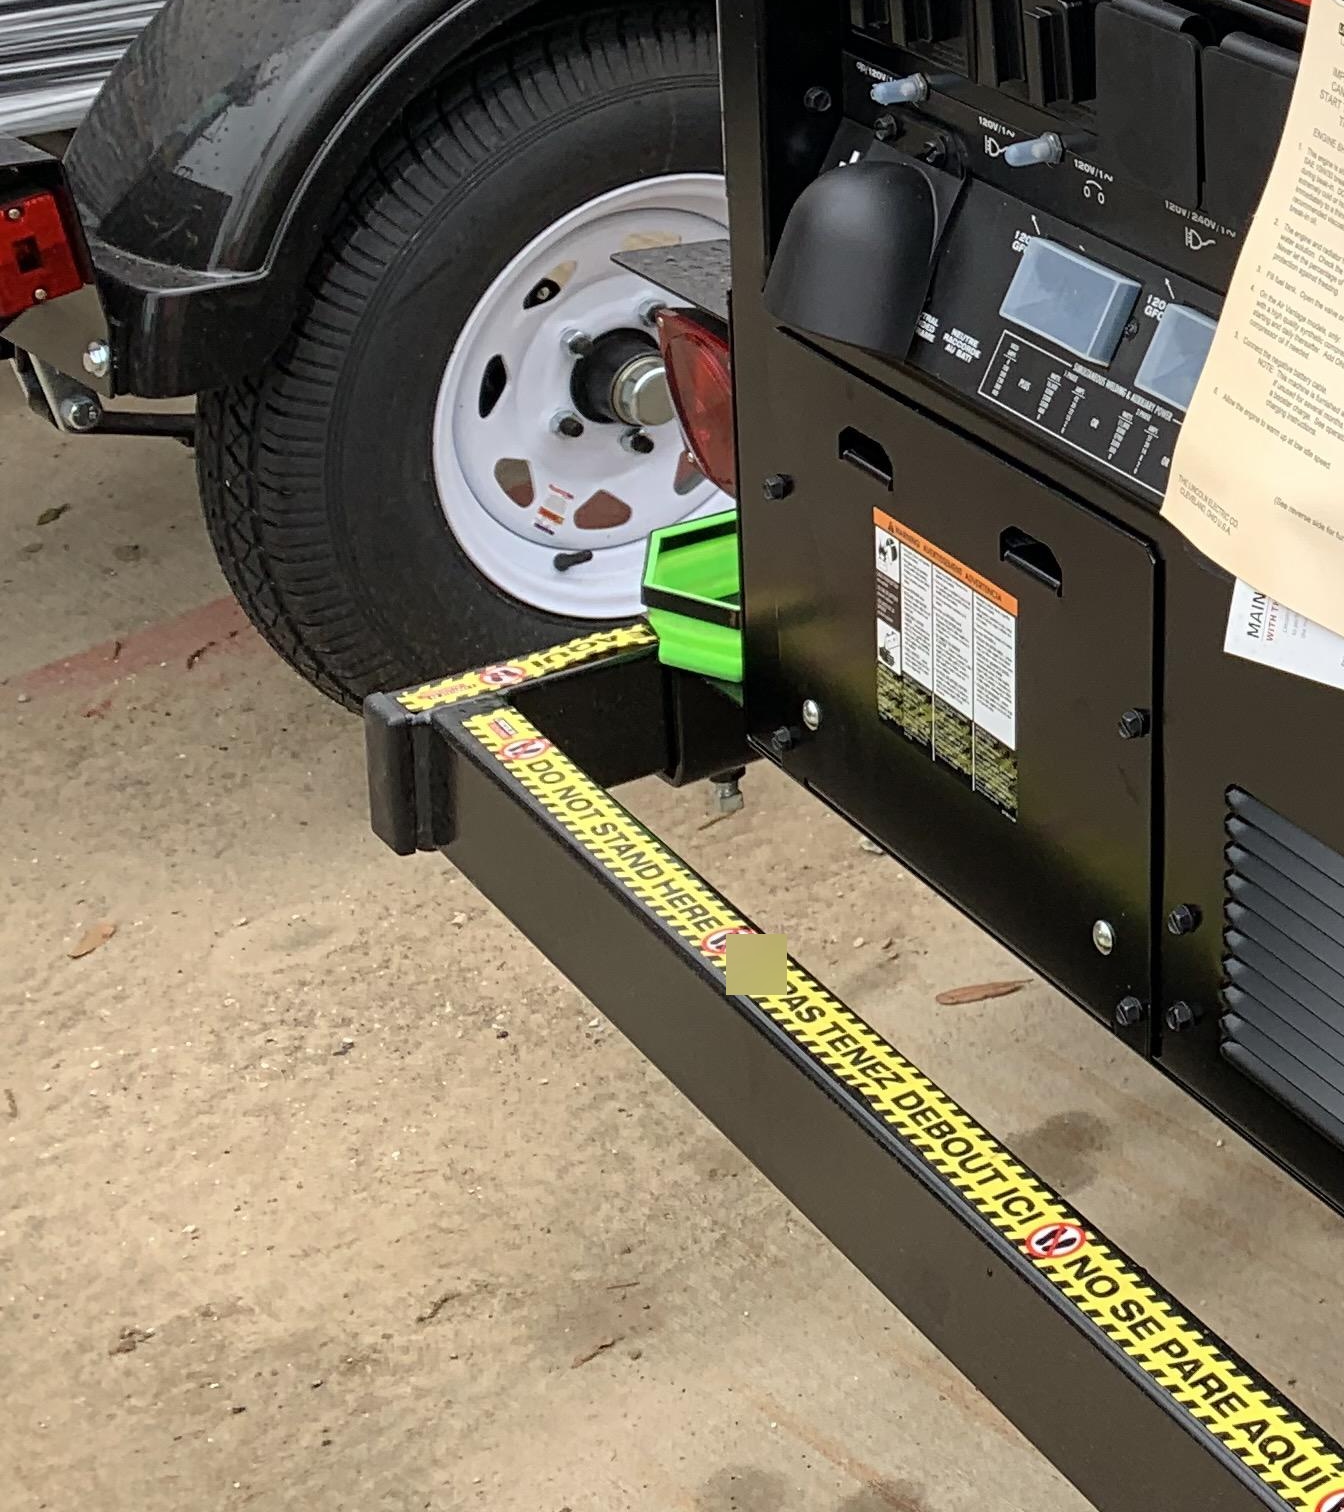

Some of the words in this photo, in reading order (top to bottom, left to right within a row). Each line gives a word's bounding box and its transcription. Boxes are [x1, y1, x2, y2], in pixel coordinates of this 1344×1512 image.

[1319, 89, 1343, 110] START
[1331, 81, 1344, 98] CAN
[951, 328, 979, 348] NEUTRE
[944, 344, 958, 356] AU
[1154, 403, 1173, 422] POWER
[1273, 496, 1289, 511] (See
[1289, 506, 1311, 523] reverse
[1312, 517, 1326, 531] side
[1326, 525, 1336, 536] for
[527, 759, 566, 785] DO
[552, 784, 605, 821] NOT
[590, 821, 665, 881] STAND
[653, 877, 724, 933] HERE
[817, 1021, 906, 1090] TENEZ
[891, 1089, 1015, 1186] DEBOUT
[992, 1187, 1045, 1226] ICI
[1063, 1255, 1120, 1298] NO
[1109, 1299, 1165, 1340] SE
[1151, 1337, 1250, 1419] PARE
